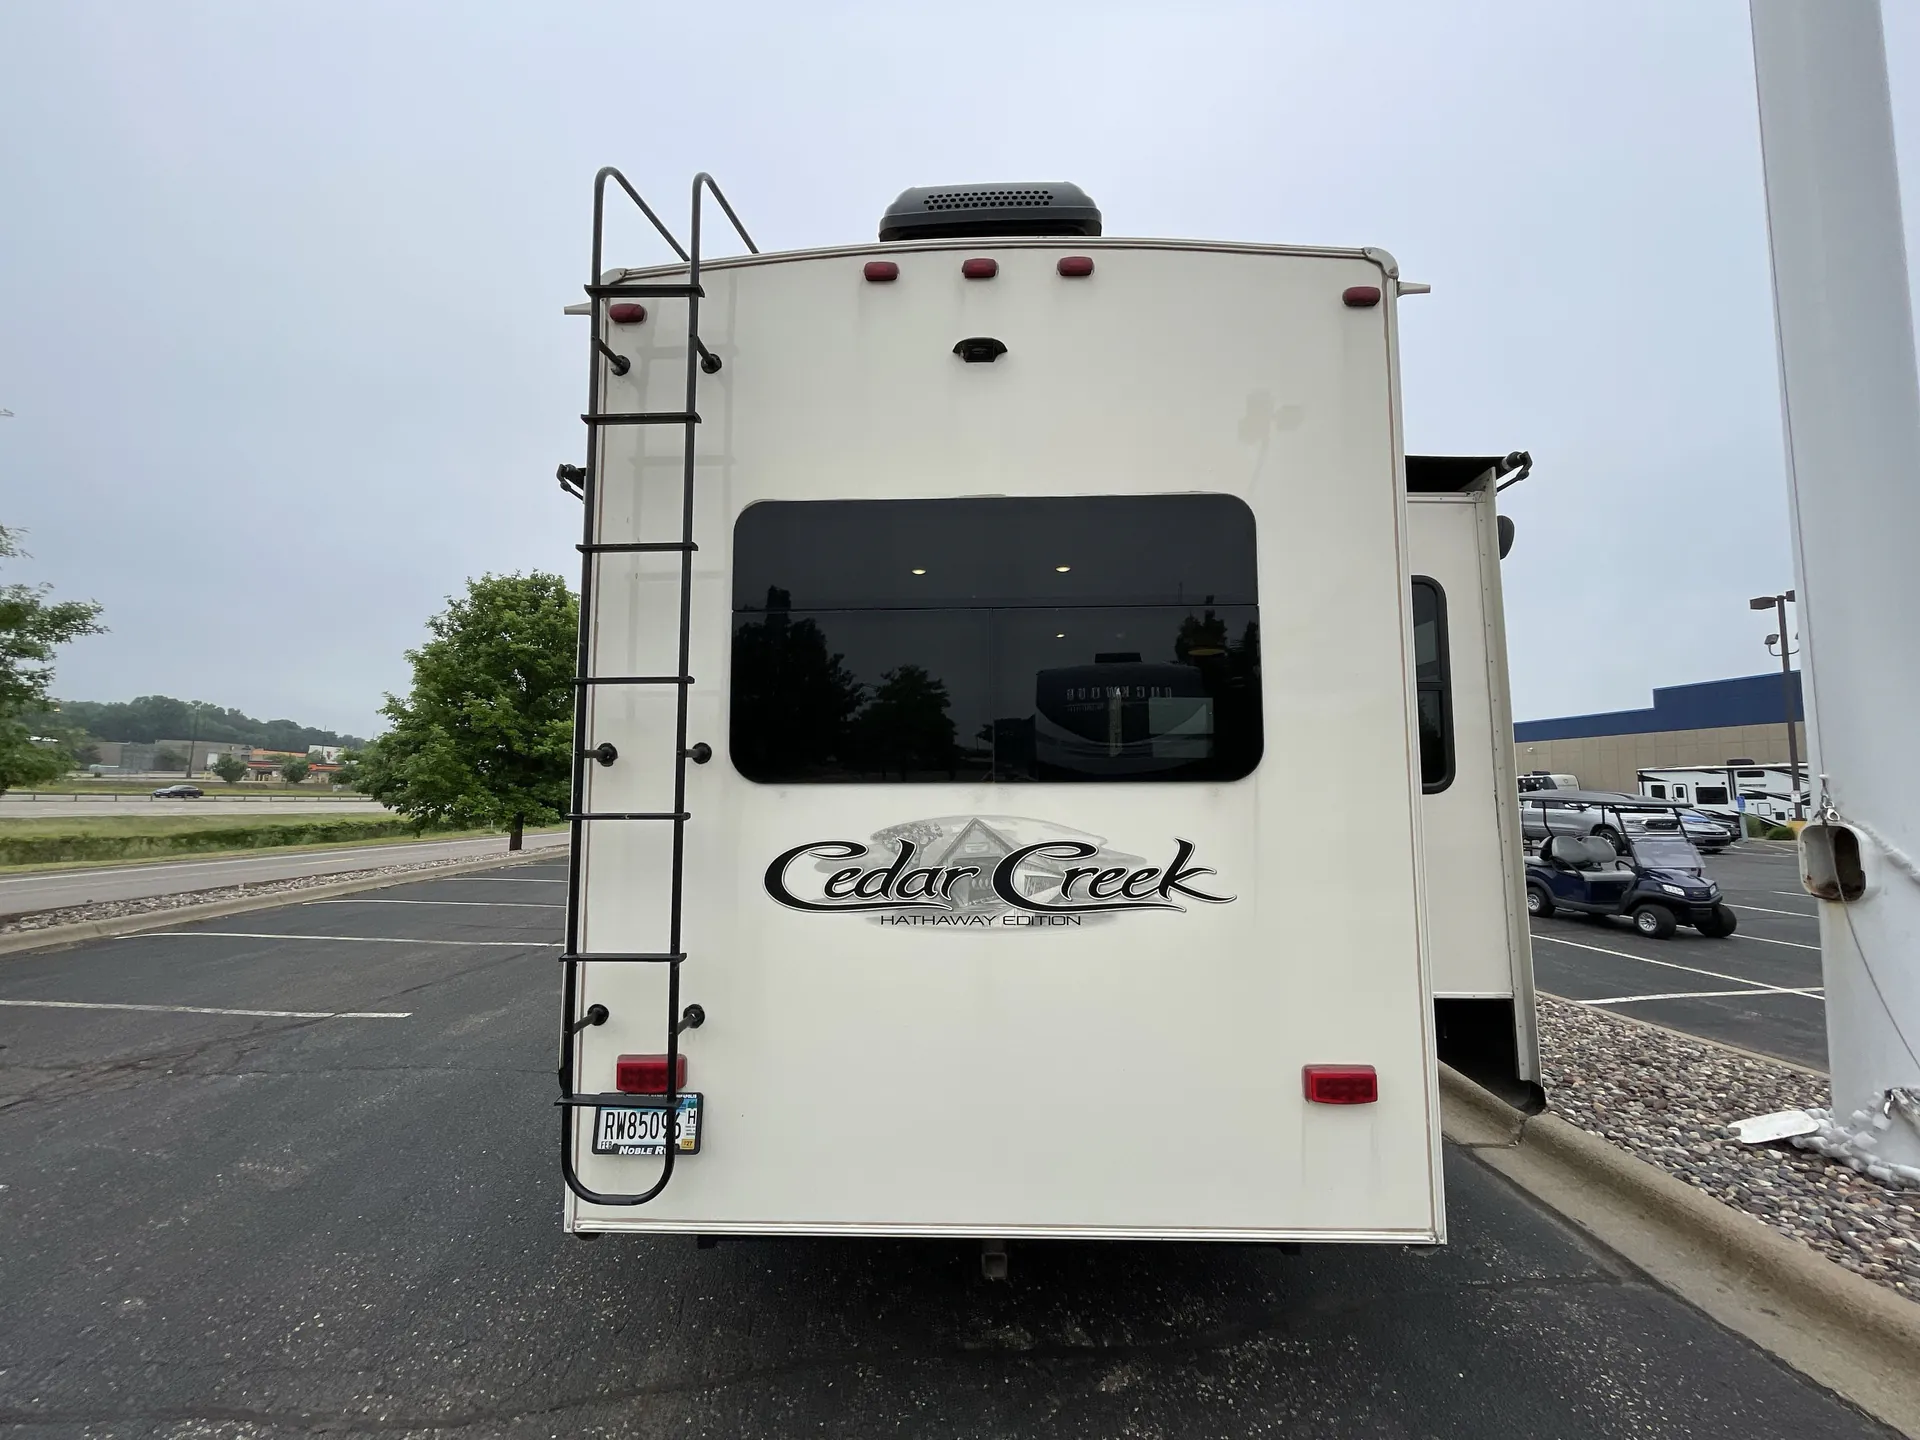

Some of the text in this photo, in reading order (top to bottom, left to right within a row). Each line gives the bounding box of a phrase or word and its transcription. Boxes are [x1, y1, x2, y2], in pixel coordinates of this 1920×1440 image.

[763, 836, 1238, 913] Cedar Creek
[880, 914, 1081, 926] HATHAWAY EDITION
